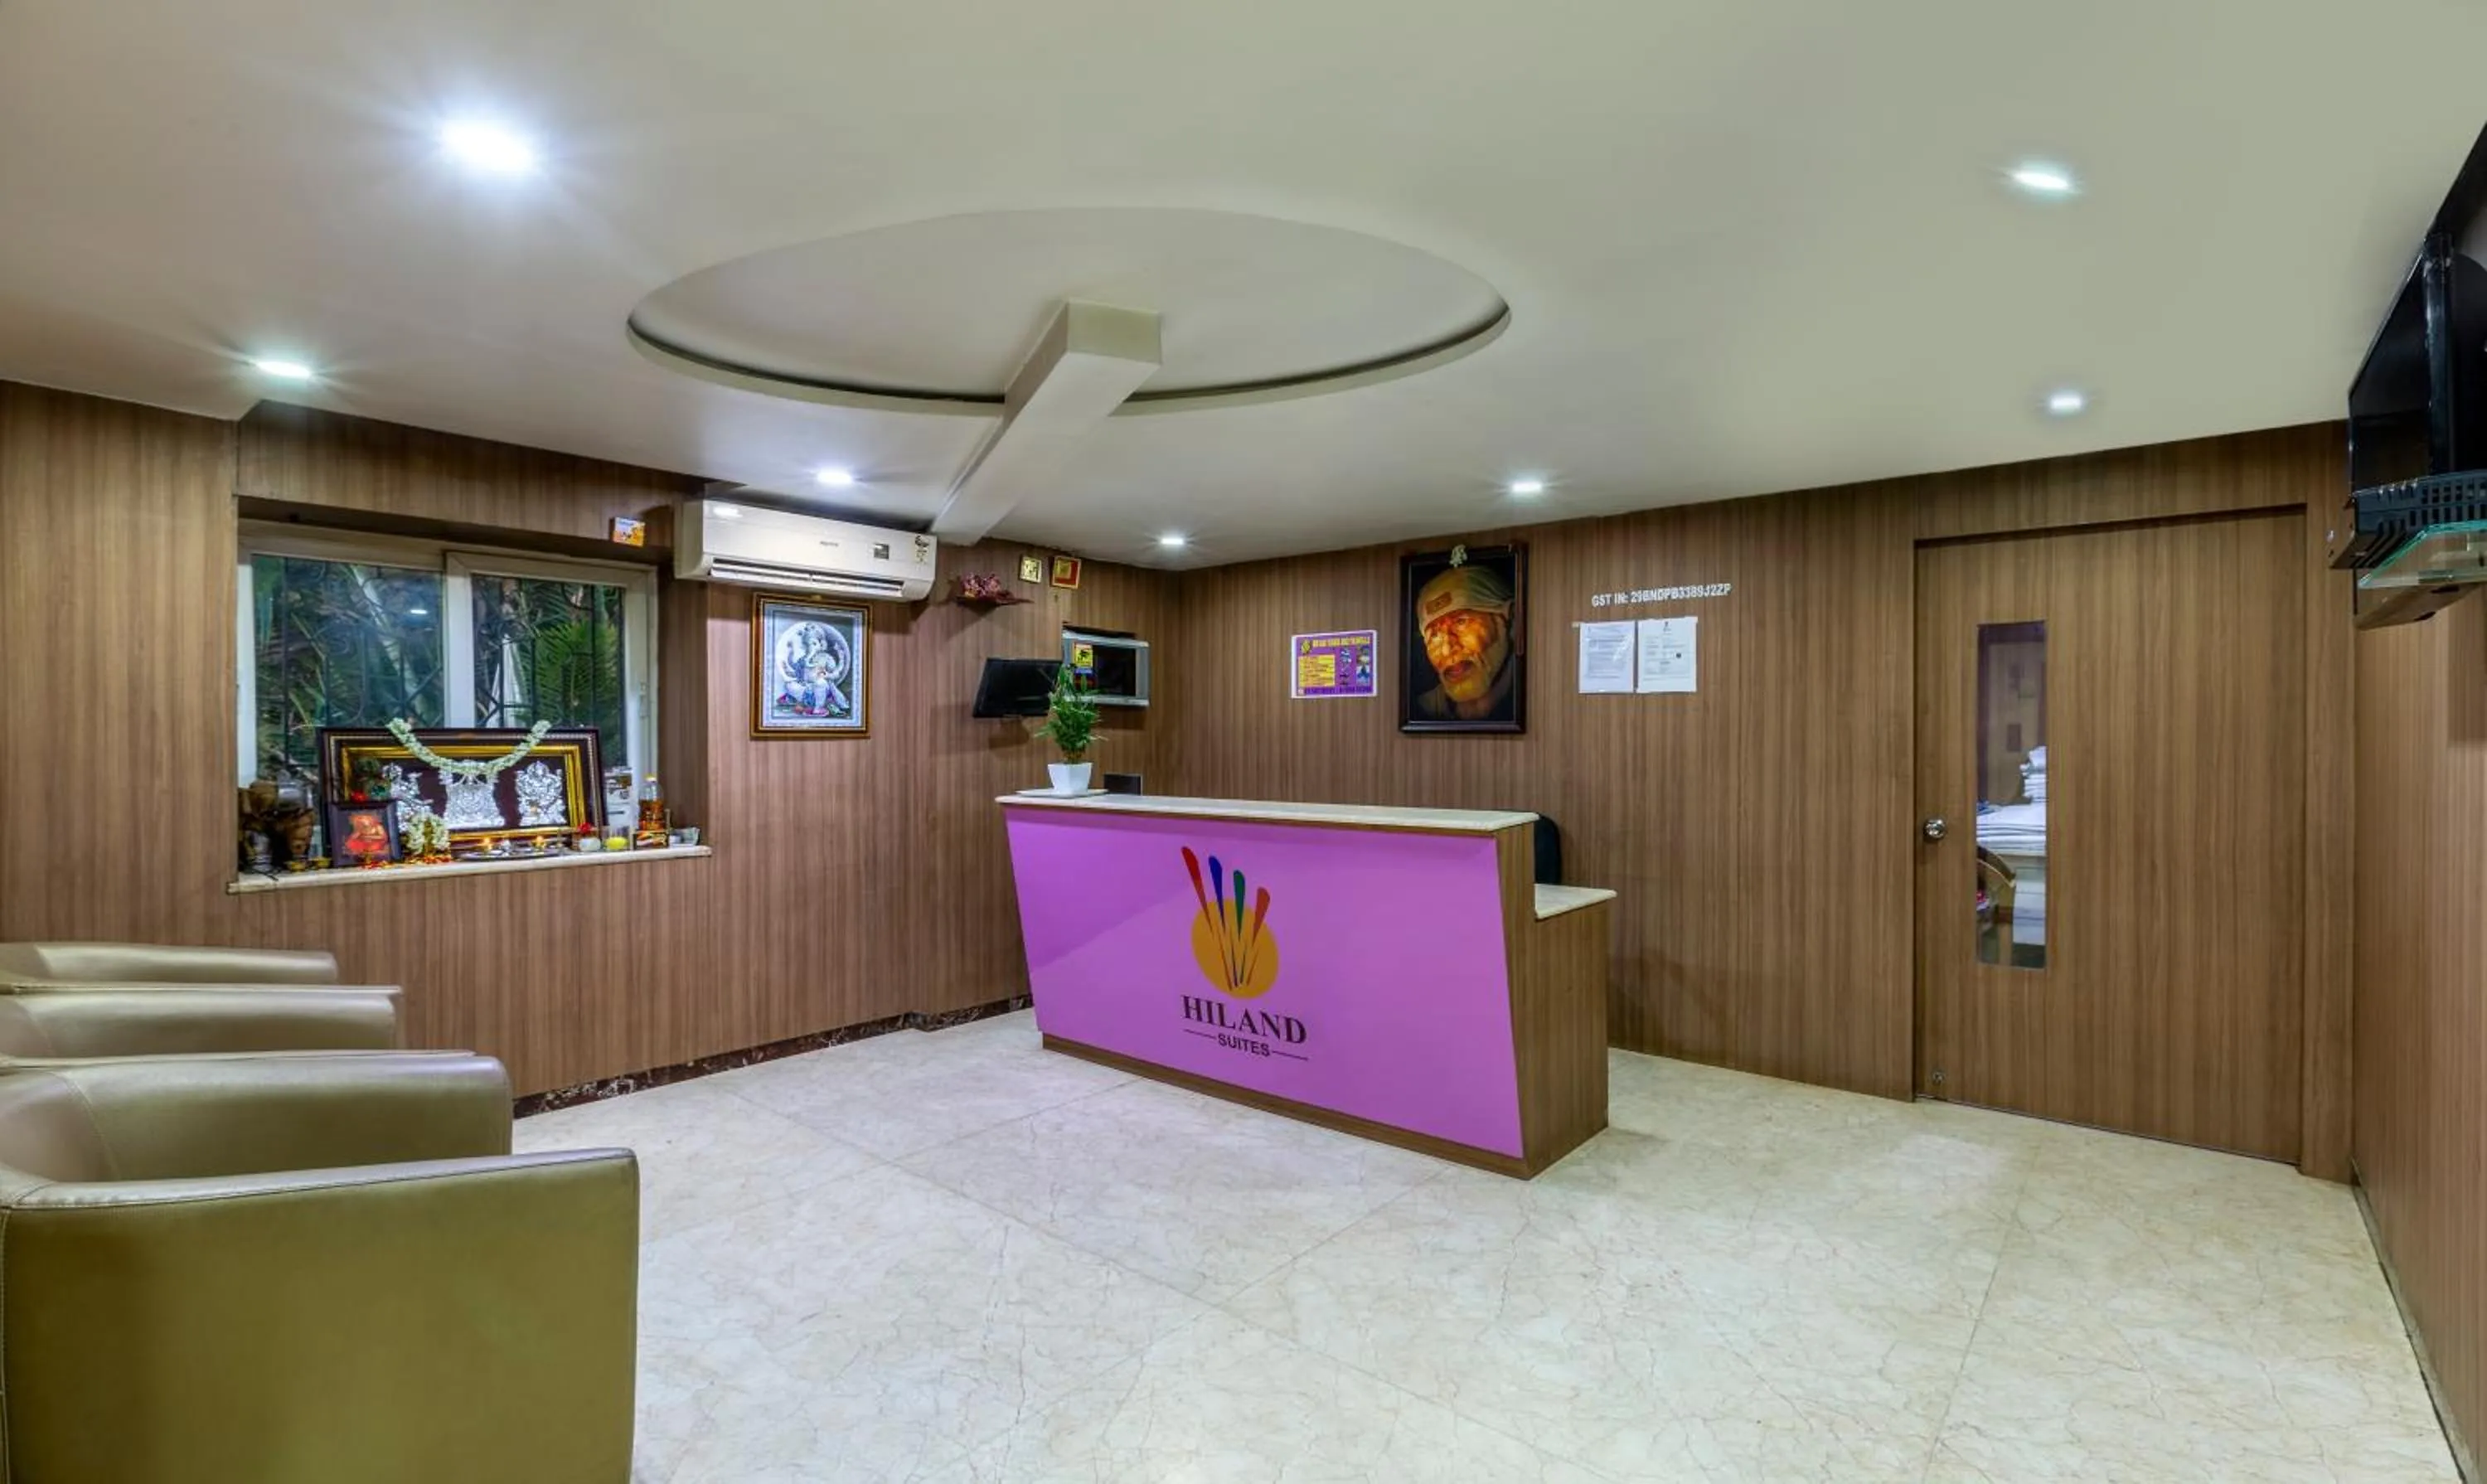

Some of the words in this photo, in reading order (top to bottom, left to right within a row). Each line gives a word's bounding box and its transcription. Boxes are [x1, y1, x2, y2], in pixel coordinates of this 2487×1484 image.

[1591, 594, 1612, 607] GST
[1181, 995, 1307, 1044] HILAND
[1218, 1034, 1270, 1056] SUITES
